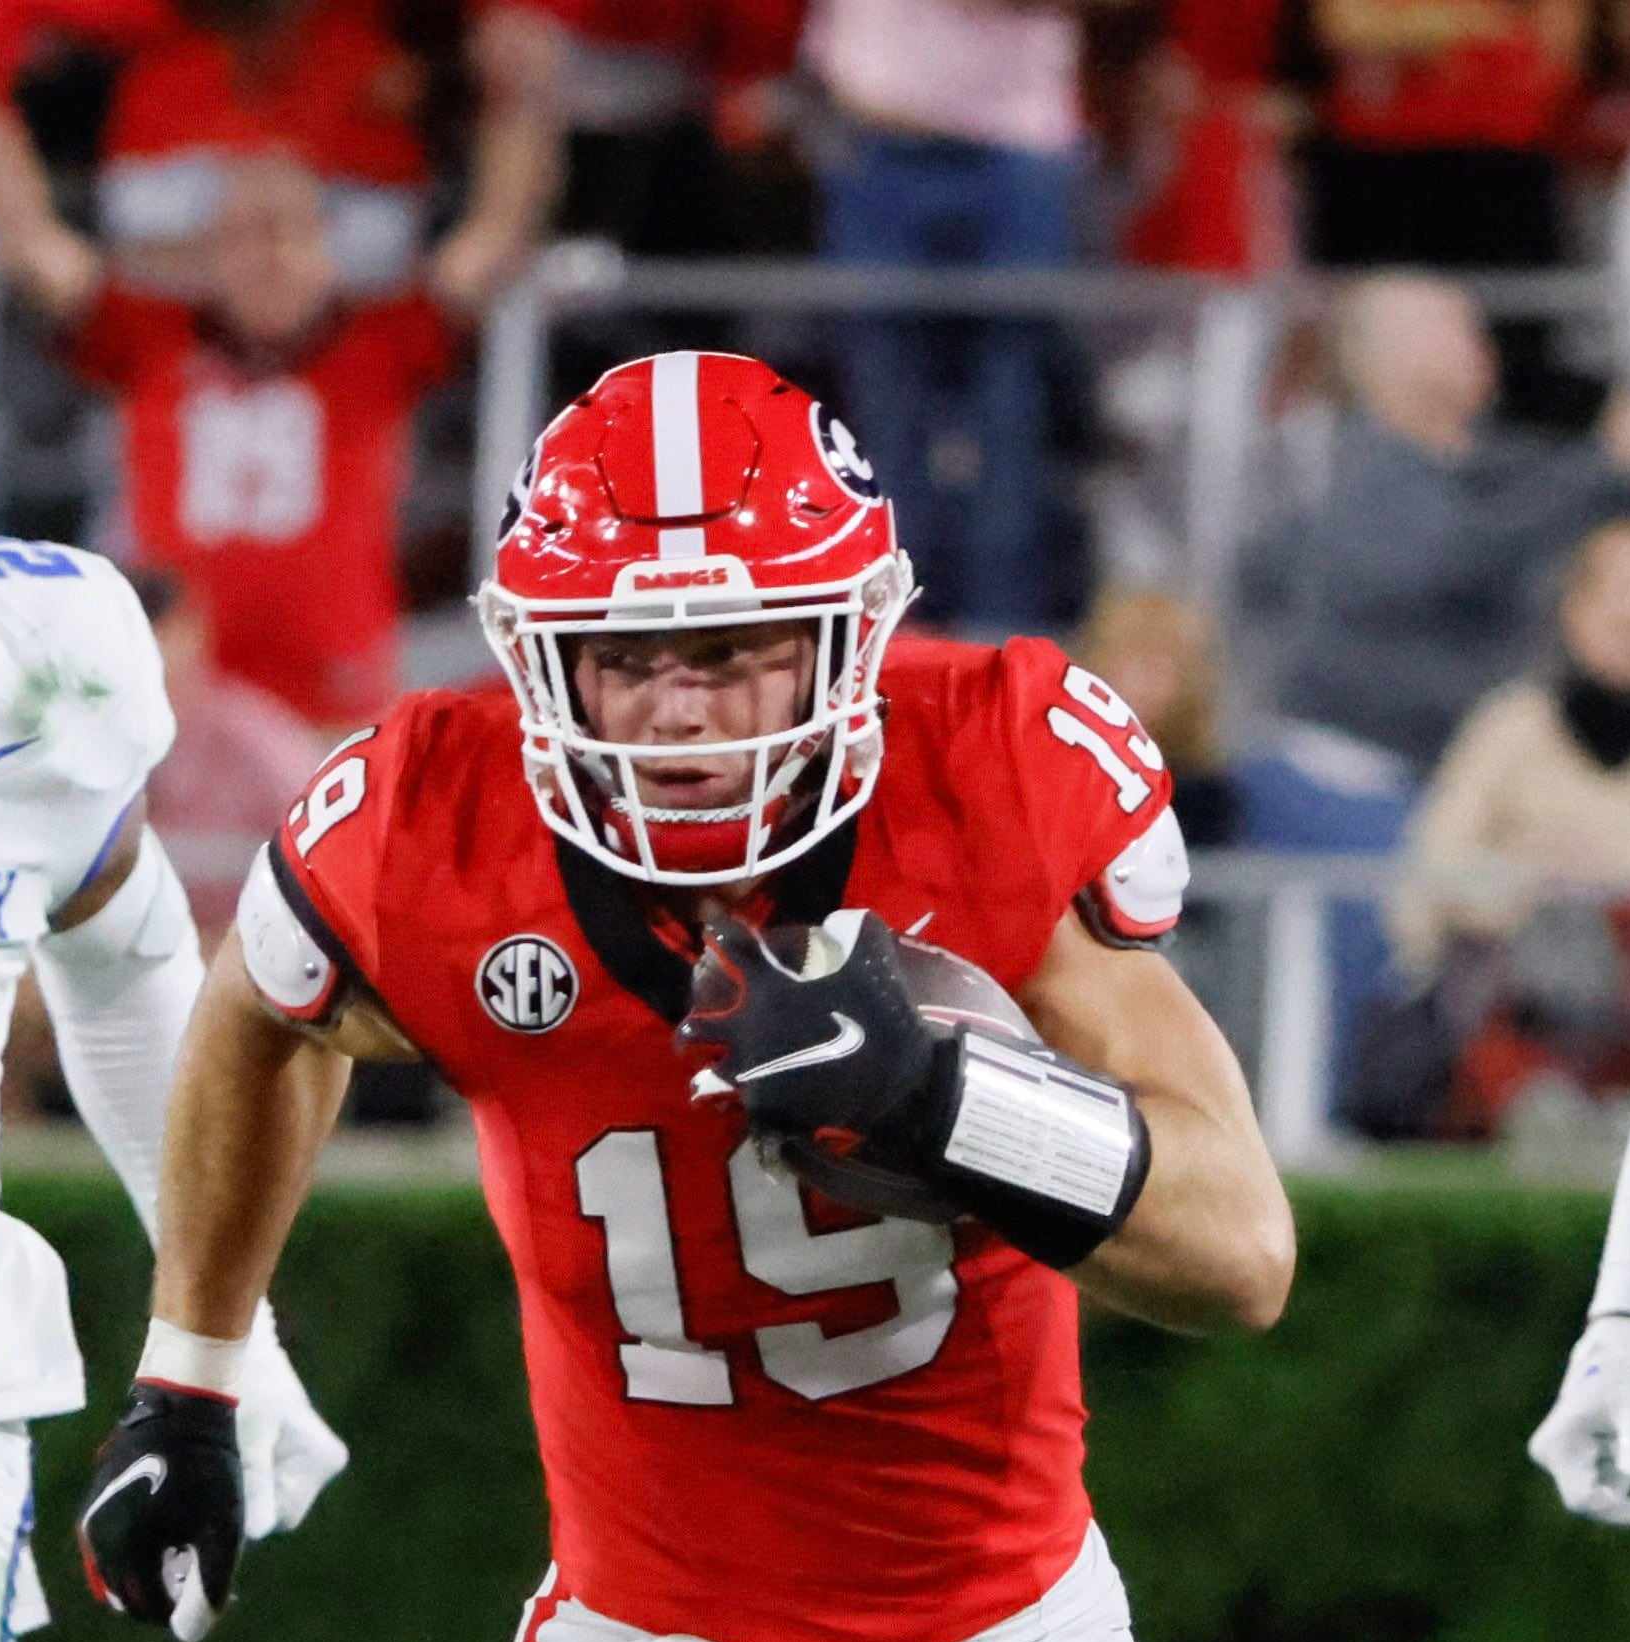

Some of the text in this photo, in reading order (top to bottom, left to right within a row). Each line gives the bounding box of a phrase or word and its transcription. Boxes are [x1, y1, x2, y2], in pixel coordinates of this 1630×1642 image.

[634, 568, 729, 592] DAWGS
[1047, 665, 1164, 814] 19
[485, 942, 569, 1025] SEC
